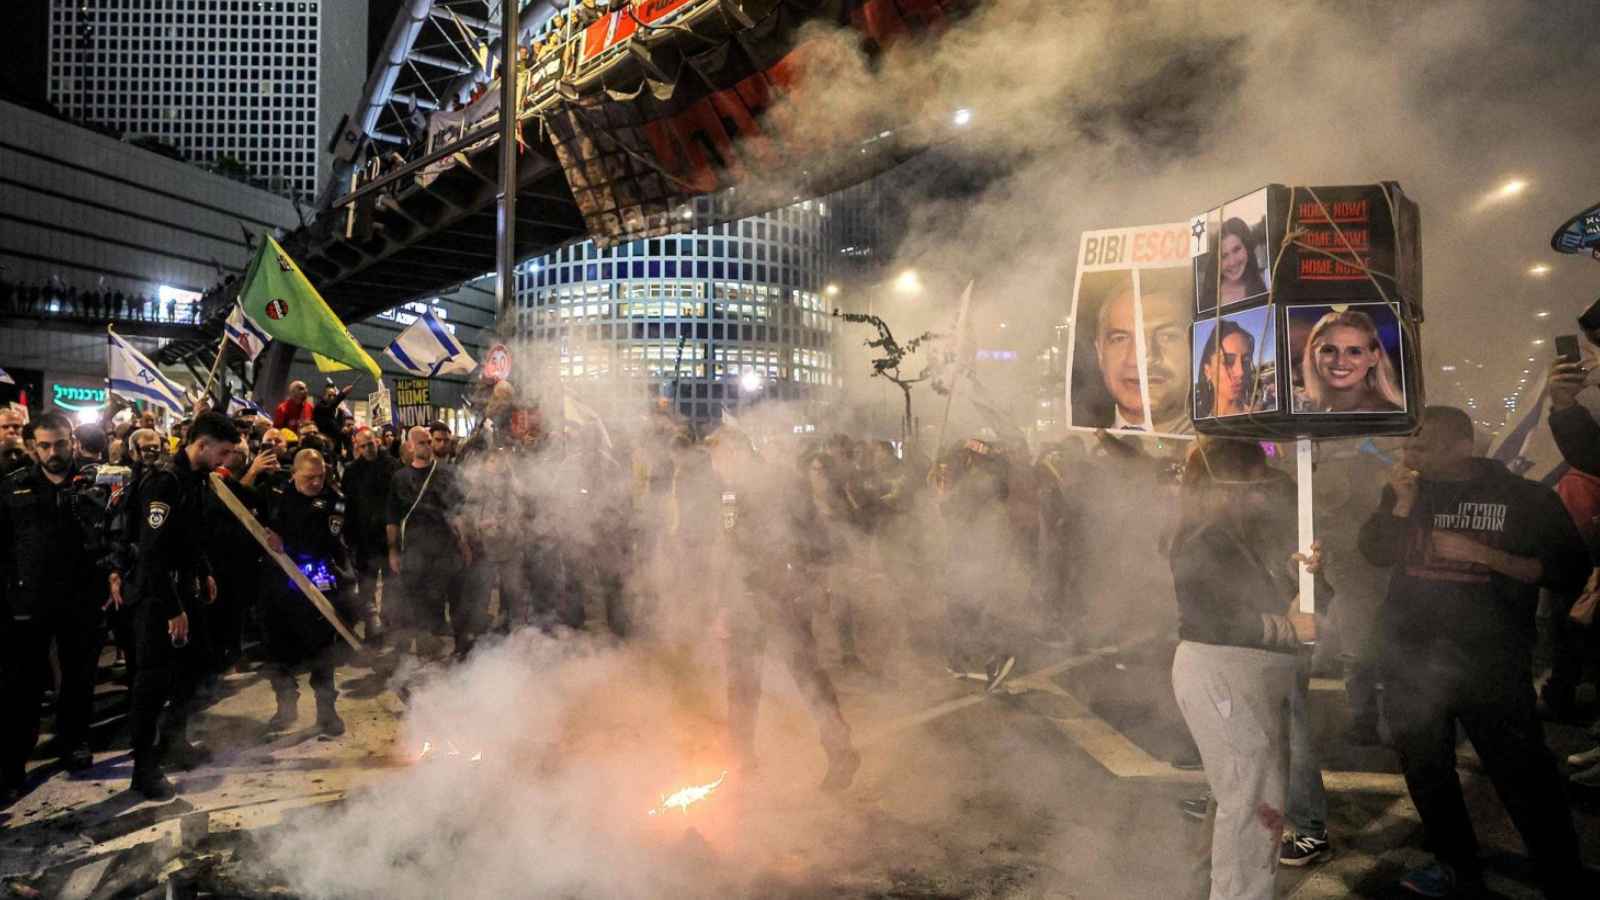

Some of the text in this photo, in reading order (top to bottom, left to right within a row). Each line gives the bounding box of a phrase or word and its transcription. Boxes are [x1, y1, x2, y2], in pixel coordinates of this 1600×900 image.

[1084, 233, 1126, 266] BIBI
[1301, 256, 1330, 274] HOME
[398, 388, 430, 405] HOME
[400, 405, 433, 427] NOW!
[1471, 516, 1505, 532] אותם
